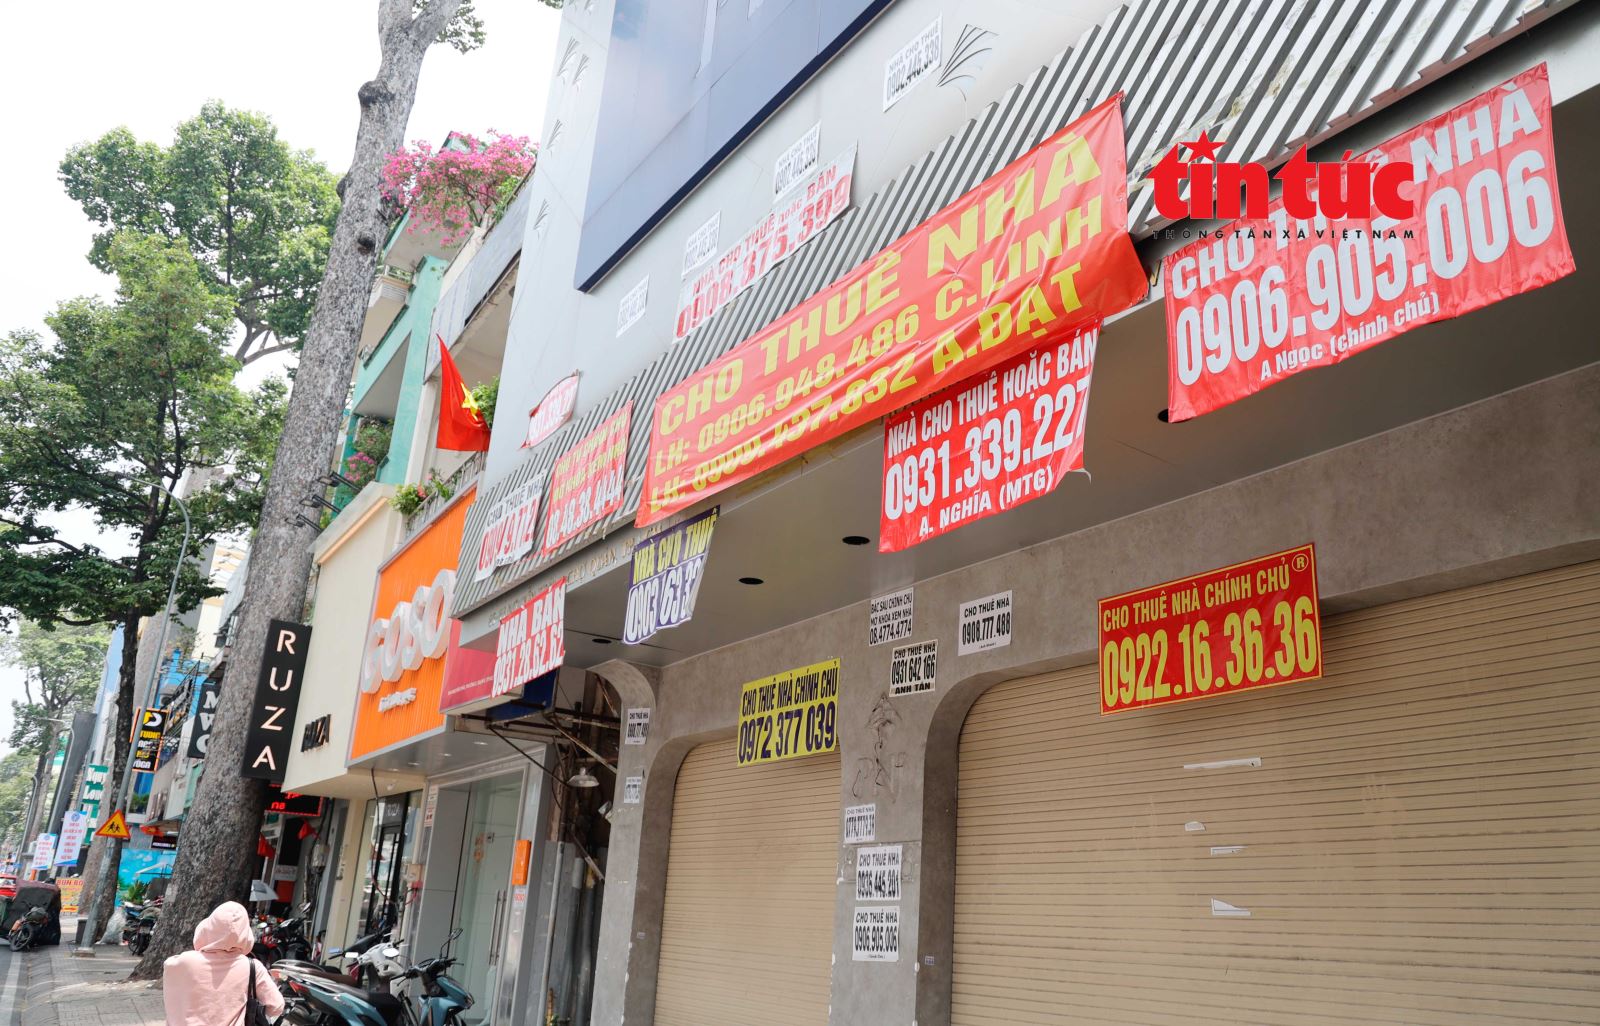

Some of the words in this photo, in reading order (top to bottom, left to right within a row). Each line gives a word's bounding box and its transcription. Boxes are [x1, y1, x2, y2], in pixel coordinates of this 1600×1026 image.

[906, 41, 919, 59] CHO
[1172, 225, 1255, 299] CHO
[1409, 81, 1542, 185] NHÀ
[661, 358, 744, 436] CHO
[760, 250, 902, 376] THUÊ
[927, 131, 1102, 279] NHÀ
[1176, 150, 1554, 385] 0906.905.006
[654, 438, 690, 477] LH:
[935, 193, 1102, 320] C.LINH
[932, 262, 1083, 375] A.ĐẠT
[1261, 360, 1271, 381] A
[1275, 343, 1324, 371] Ngọc
[1330, 313, 1389, 357] (chính
[1393, 291, 1440, 327] chủ)
[888, 411, 917, 458] NHÀ
[921, 399, 953, 442] CHO
[957, 371, 998, 425] THUÊ
[1003, 350, 1052, 405] HOẶC
[1057, 328, 1098, 379] BÁN
[884, 373, 1091, 521] 0931.339.227
[919, 516, 934, 537] A.
[940, 489, 993, 528] NGHĨA
[1000, 466, 1053, 510] (MTG)
[633, 538, 655, 585] NHÀ
[657, 530, 682, 573] CHO
[1103, 605, 1129, 632] CHO
[1133, 590, 1167, 625] THUÊ
[1172, 582, 1201, 616] NHÀ
[1205, 573, 1251, 608] CHÍNH
[1256, 557, 1290, 595] CHỦ
[496, 605, 527, 658] NHÀ
[531, 583, 566, 637] BÁN
[892, 609, 901, 621] XEM
[964, 606, 976, 618] CHO
[979, 599, 995, 614] THUÊ
[742, 689, 757, 717] CHO
[758, 677, 777, 713] THUÊ
[777, 673, 792, 709] NHÀ
[794, 668, 819, 705] CHÍNH
[820, 661, 838, 699] CHỦ
[894, 649, 906, 659] CHO
[907, 644, 922, 657] THUÊ
[1103, 596, 1317, 707] 0922.16.36.36
[252, 629, 296, 770] RUZA
[895, 685, 912, 694] ANH
[739, 715, 773, 763] 0972
[775, 708, 804, 757] 377
[806, 701, 836, 752] 039
[859, 854, 871, 866] CHO
[856, 912, 869, 923] CHO
